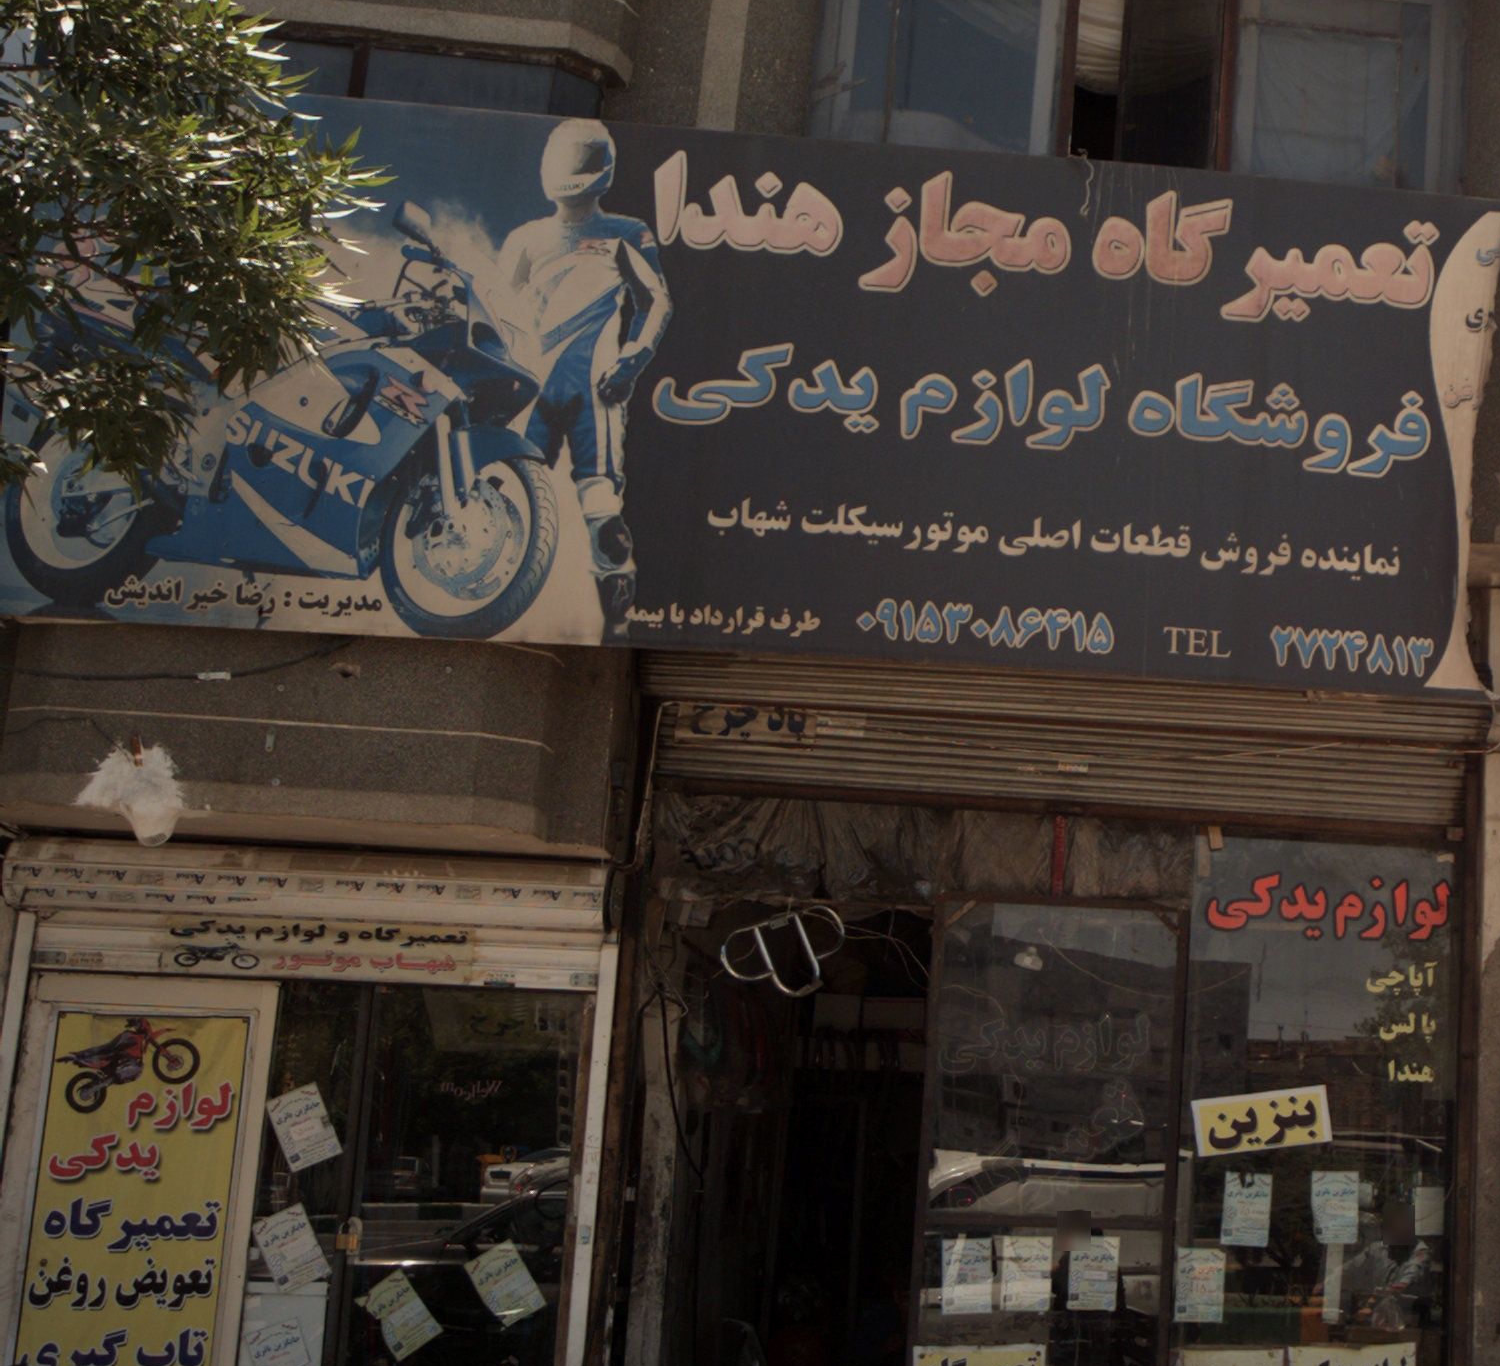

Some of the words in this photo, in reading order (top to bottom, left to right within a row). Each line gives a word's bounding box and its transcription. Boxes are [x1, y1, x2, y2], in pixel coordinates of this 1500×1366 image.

[654, 150, 844, 257] هندا
[858, 170, 1072, 297] مجاز
[653, 344, 880, 435] یدکی
[899, 359, 1113, 450] لوازم
[1129, 371, 1432, 479] فروشگاه
[226, 411, 376, 509] SUZUKI
[706, 497, 792, 538] شهاب
[998, 517, 1083, 557] اصلی
[1090, 521, 1192, 558] قطعات
[1200, 531, 1292, 576] فروش
[1300, 543, 1401, 582] نماینده
[105, 575, 183, 609] اندیش
[187, 581, 228, 611] خیر
[237, 581, 276, 615] رضا
[298, 590, 383, 617] مدیریت
[625, 603, 666, 629] بیمه
[669, 602, 685, 630] با
[769, 608, 821, 638] طرف
[856, 598, 1115, 655] ۰۹۱۵۳۰۸۶۴۱۵
[1163, 626, 1232, 658] TEL
[1270, 624, 1435, 677] ۲۷۲۴۸۱۳
[1205, 872, 1329, 939] یدکی
[1335, 875, 1452, 941] لوازم
[170, 919, 245, 940] یدکی
[255, 923, 326, 943] لوازم
[274, 950, 363, 973] موتور
[369, 953, 459, 974] شهاب
[1387, 1059, 1435, 1084] هندا
[127, 1080, 235, 1130] لوازم
[1208, 1095, 1318, 1150] بنزین
[49, 1131, 160, 1181] یدکی
[28, 1255, 107, 1309] روغن
[115, 1257, 214, 1310] تعویض
